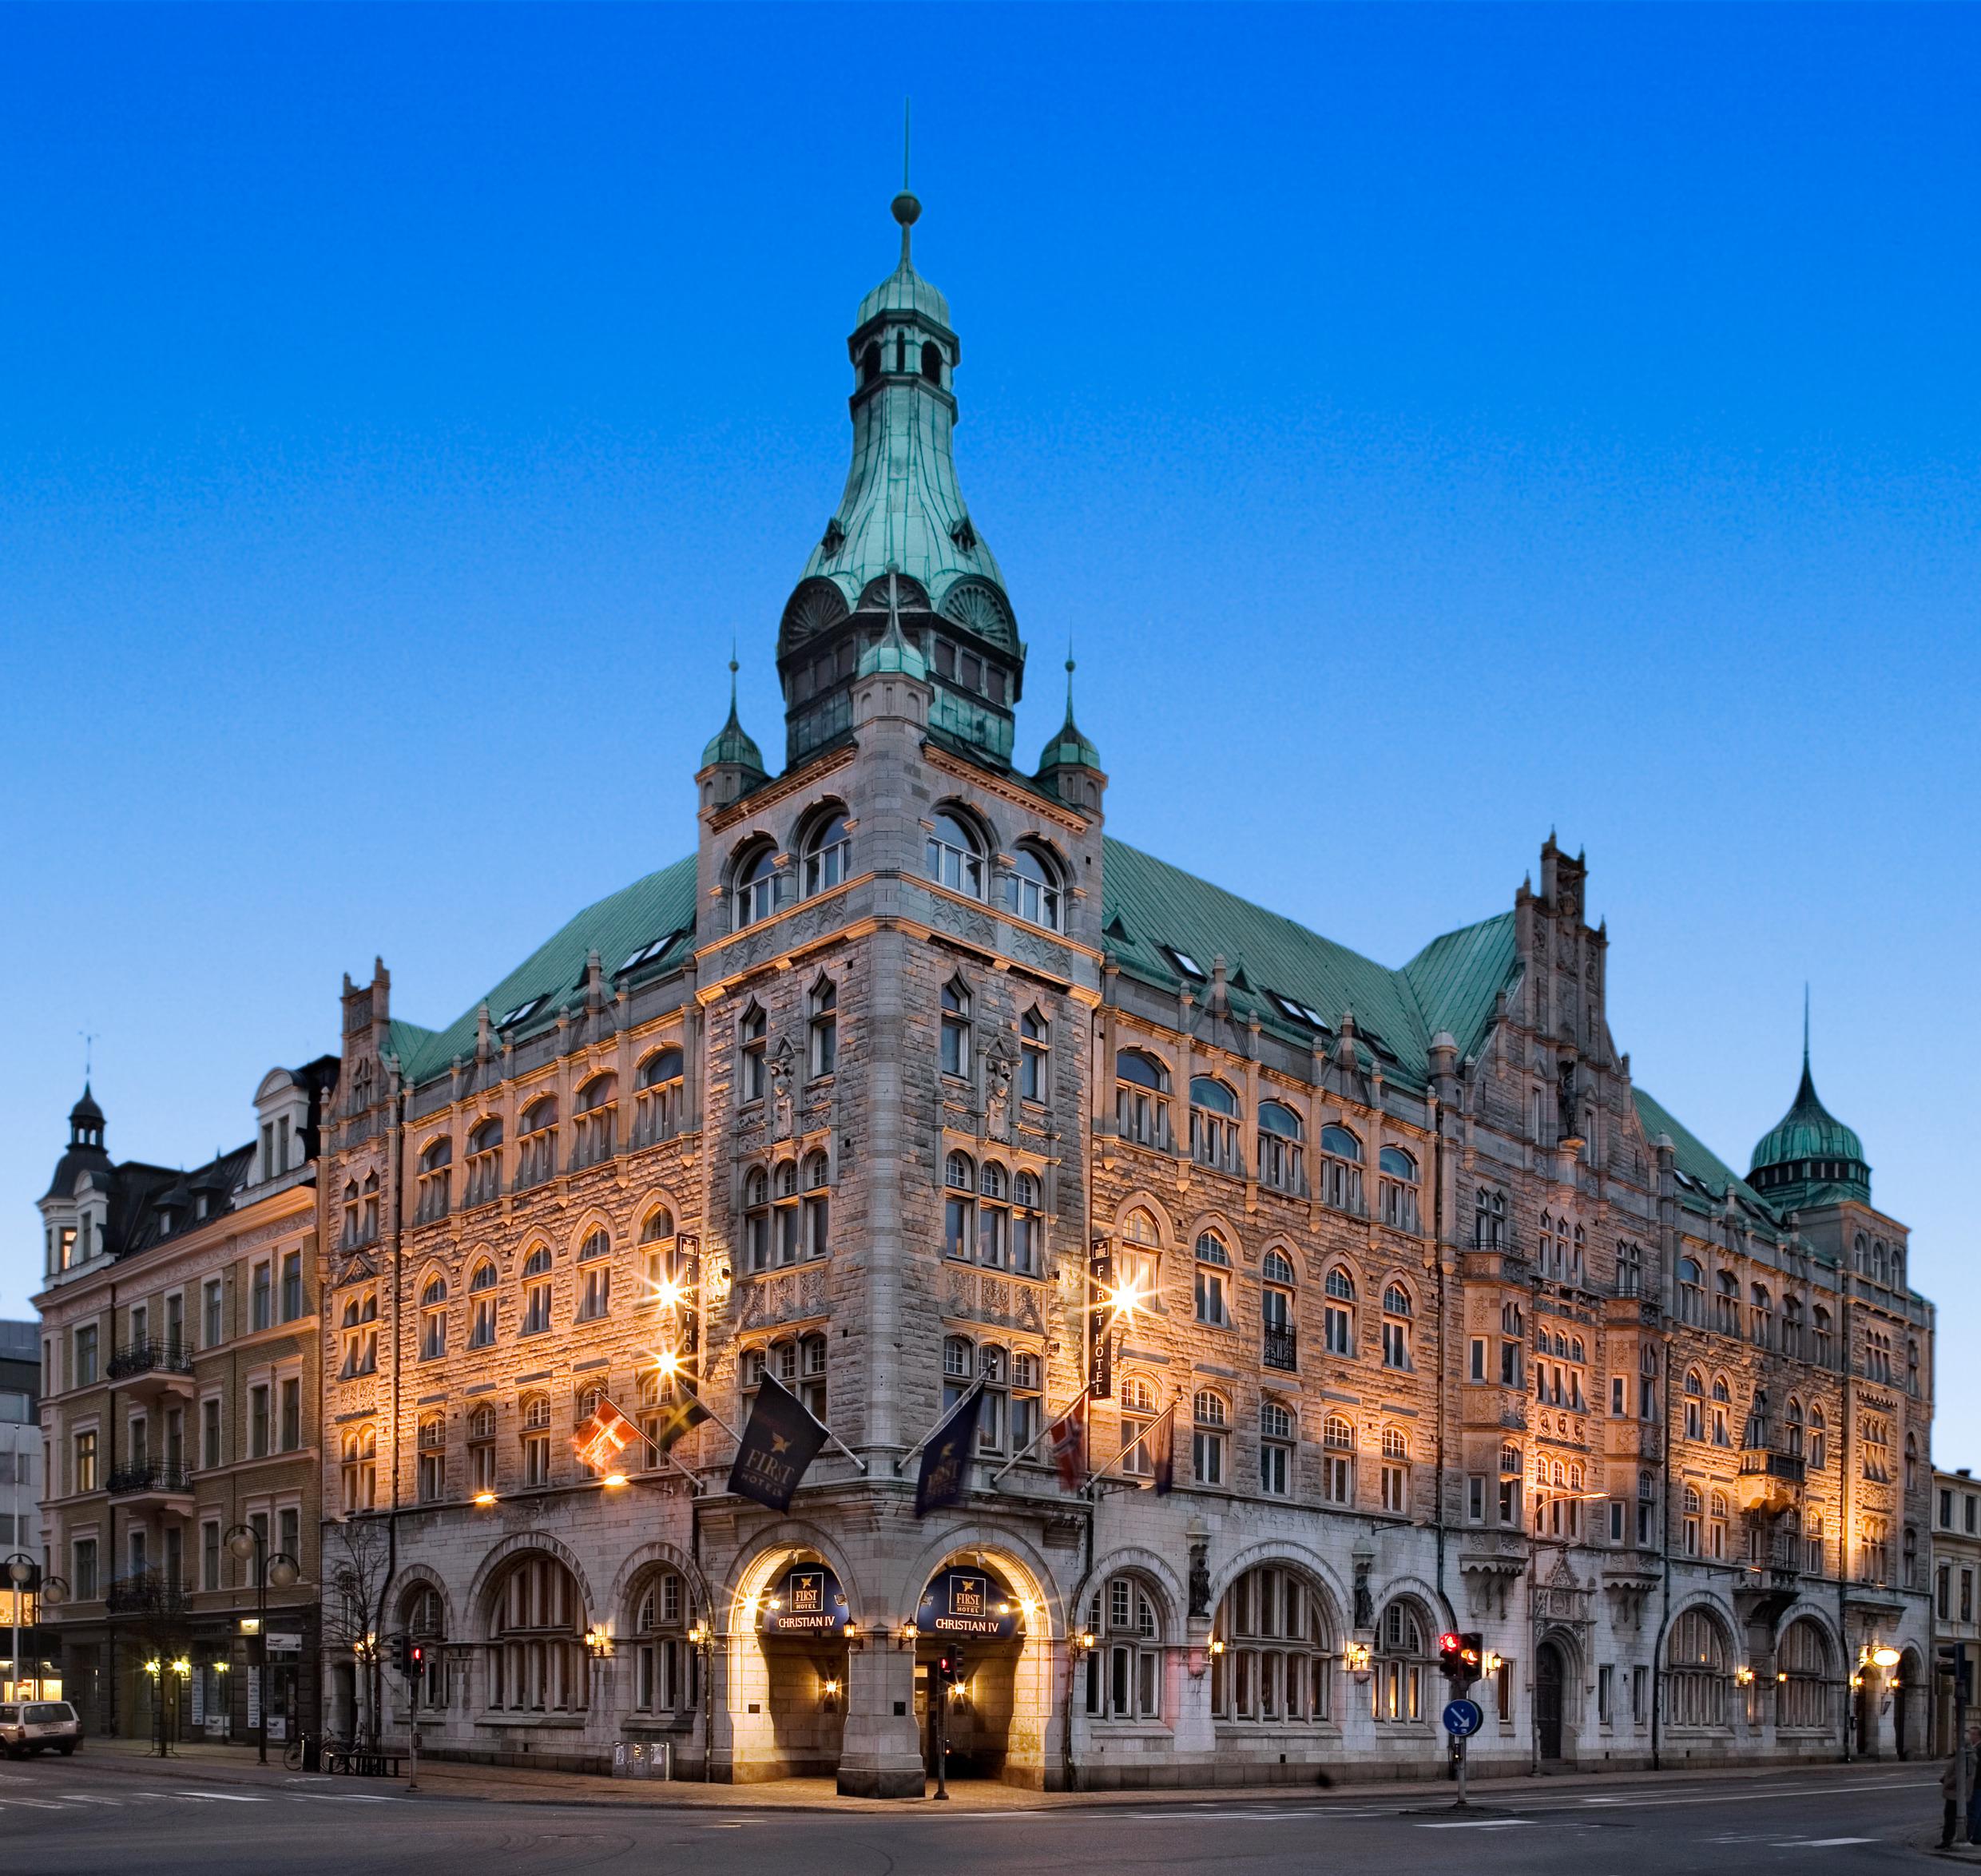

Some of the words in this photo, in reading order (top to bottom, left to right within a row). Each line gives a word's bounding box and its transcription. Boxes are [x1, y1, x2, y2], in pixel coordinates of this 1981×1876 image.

[685, 1261, 694, 1323] FIRST
[1096, 1265, 1106, 1326] FIRST
[1095, 1334, 1104, 1395] HOTEL
[744, 1449, 795, 1485] FIRST
[796, 1590, 818, 1601] FIRST
[956, 1592, 980, 1605] FIRST
[778, 1616, 823, 1628] CHRISTIAN
[824, 1616, 836, 1626] IV
[935, 1618, 986, 1632] CHRISTIAN
[988, 1622, 999, 1632] IV
